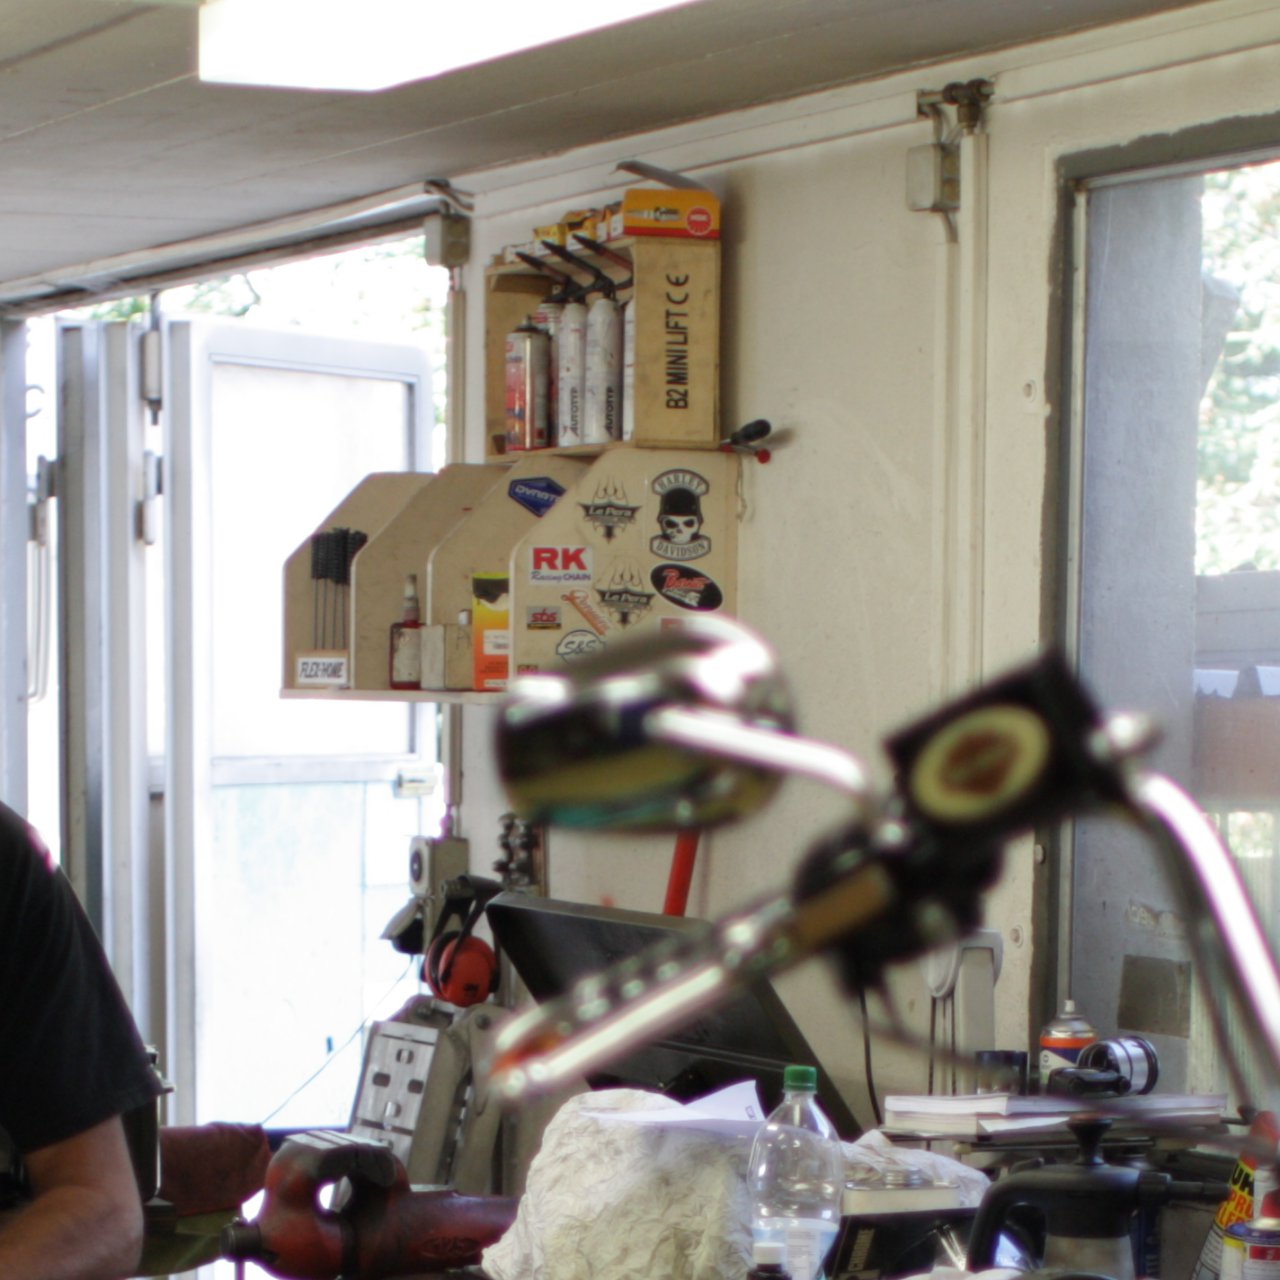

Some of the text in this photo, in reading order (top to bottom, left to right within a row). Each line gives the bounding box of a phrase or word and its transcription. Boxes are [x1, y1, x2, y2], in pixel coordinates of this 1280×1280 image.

[665, 308, 689, 346] LIFT
[665, 348, 689, 386] MINI
[665, 388, 689, 410] B2
[656, 472, 704, 490] HARLEY
[532, 547, 588, 571] RK
[656, 542, 705, 556] DAVIDSON
[563, 573, 592, 581] CHAIN
